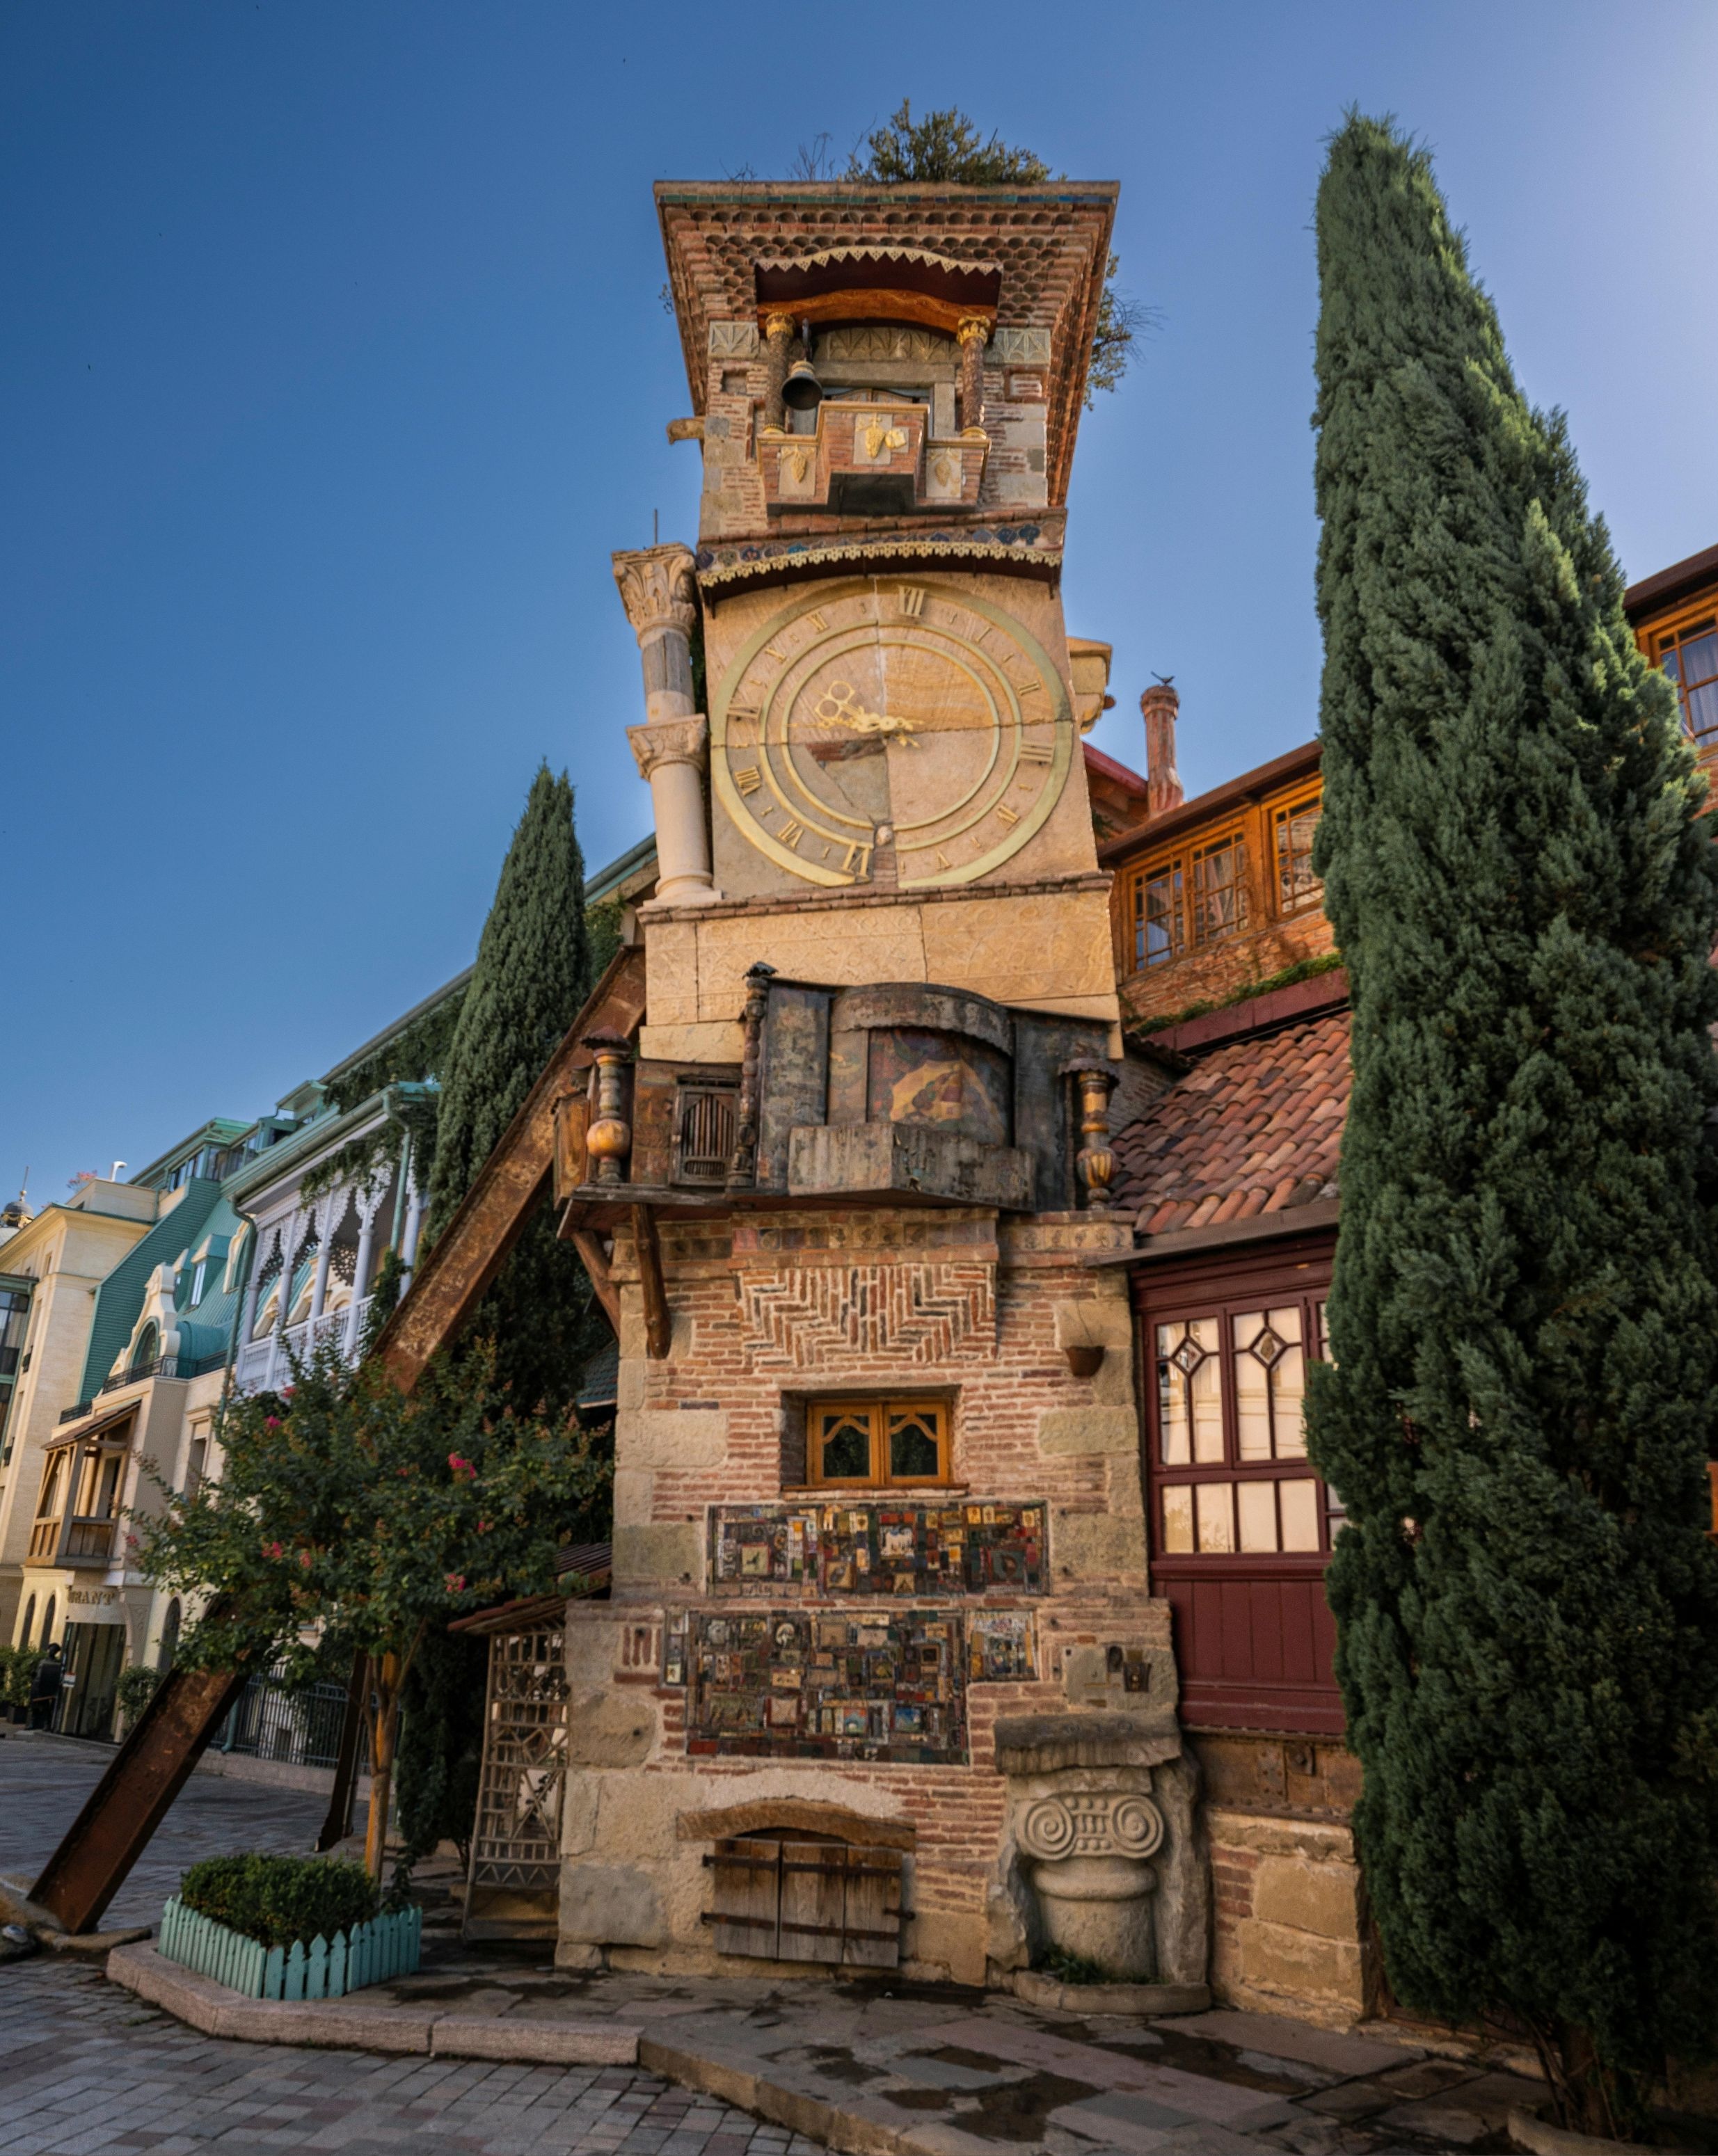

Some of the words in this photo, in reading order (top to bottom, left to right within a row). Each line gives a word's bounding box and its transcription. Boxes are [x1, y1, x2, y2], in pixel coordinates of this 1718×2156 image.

[1019, 742, 1055, 763] III
[735, 765, 763, 797] VIII
[777, 820, 804, 849] VII
[841, 840, 871, 879] VI
